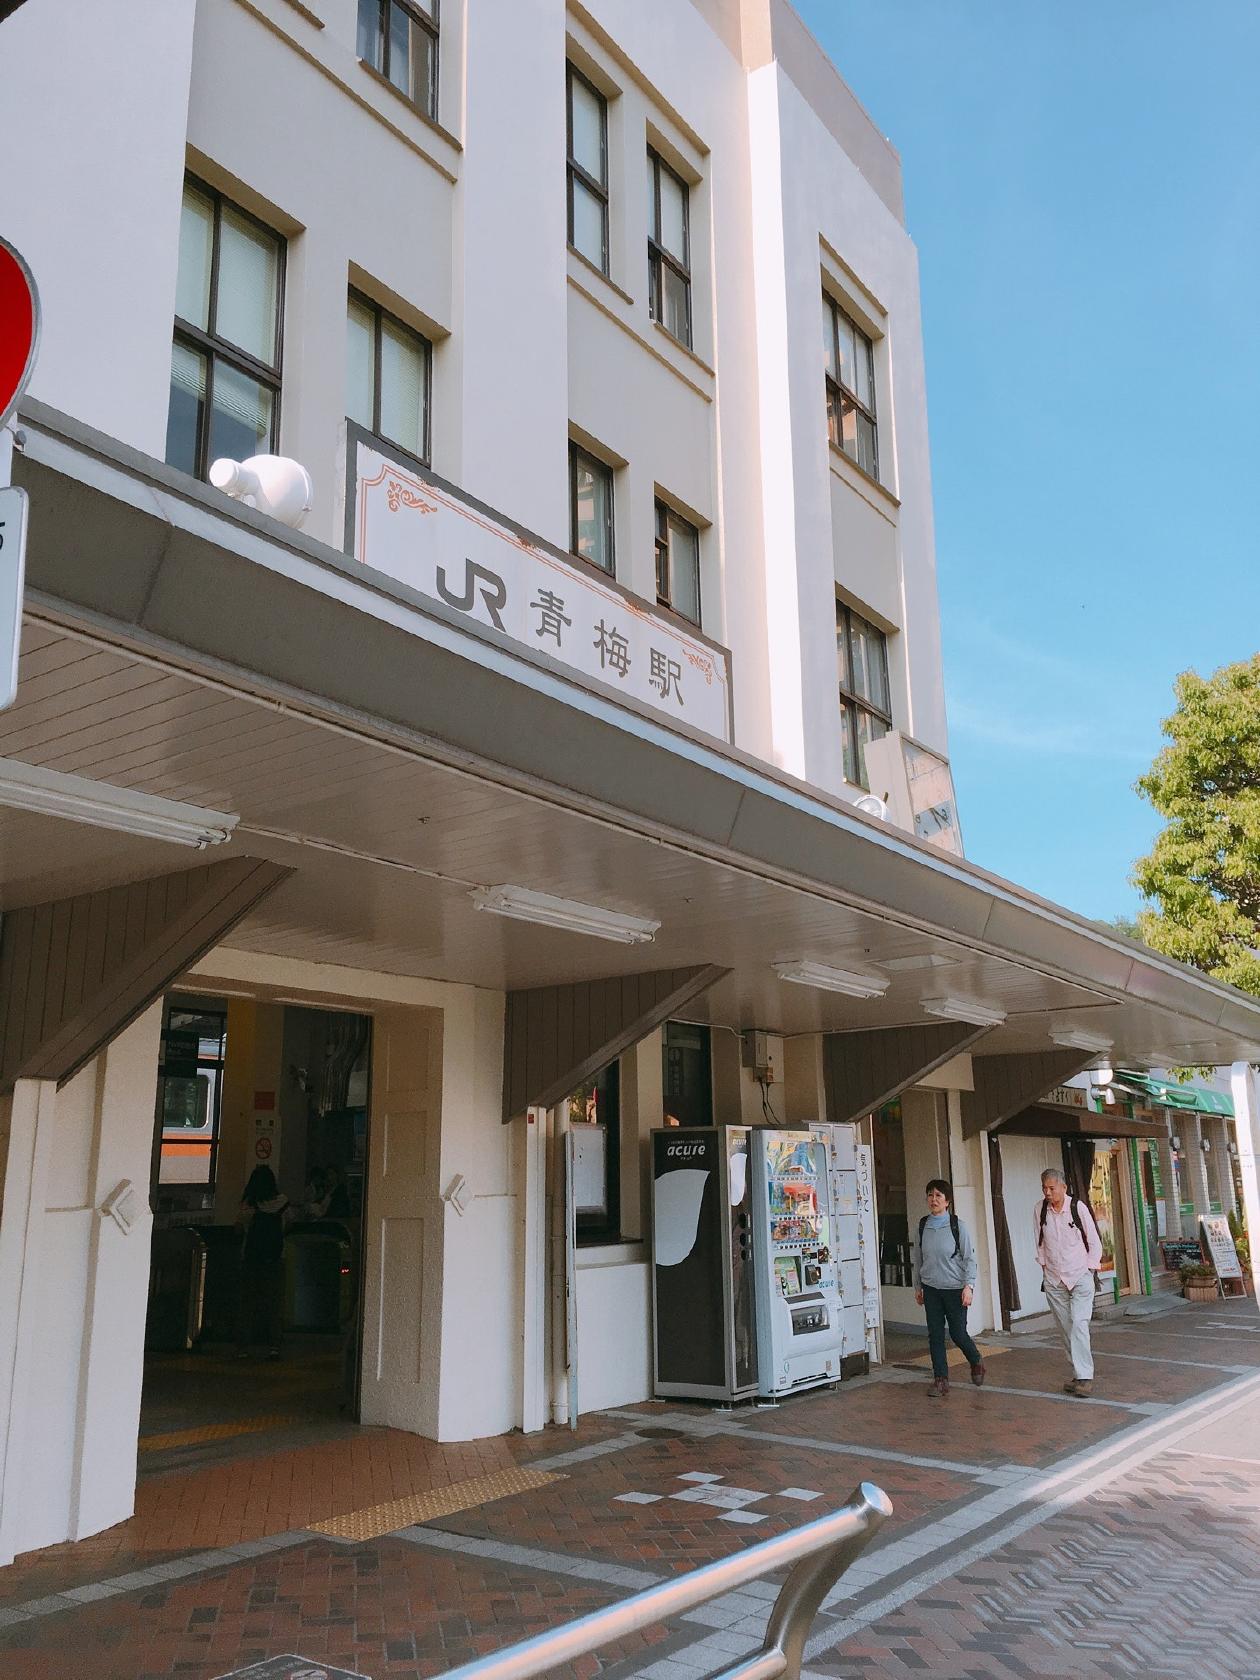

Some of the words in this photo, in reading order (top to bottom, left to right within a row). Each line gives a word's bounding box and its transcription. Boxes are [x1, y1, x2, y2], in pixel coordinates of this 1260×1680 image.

[437, 558, 507, 632] JR
[530, 588, 684, 706] 青梅駅
[667, 1145, 706, 1156] acure
